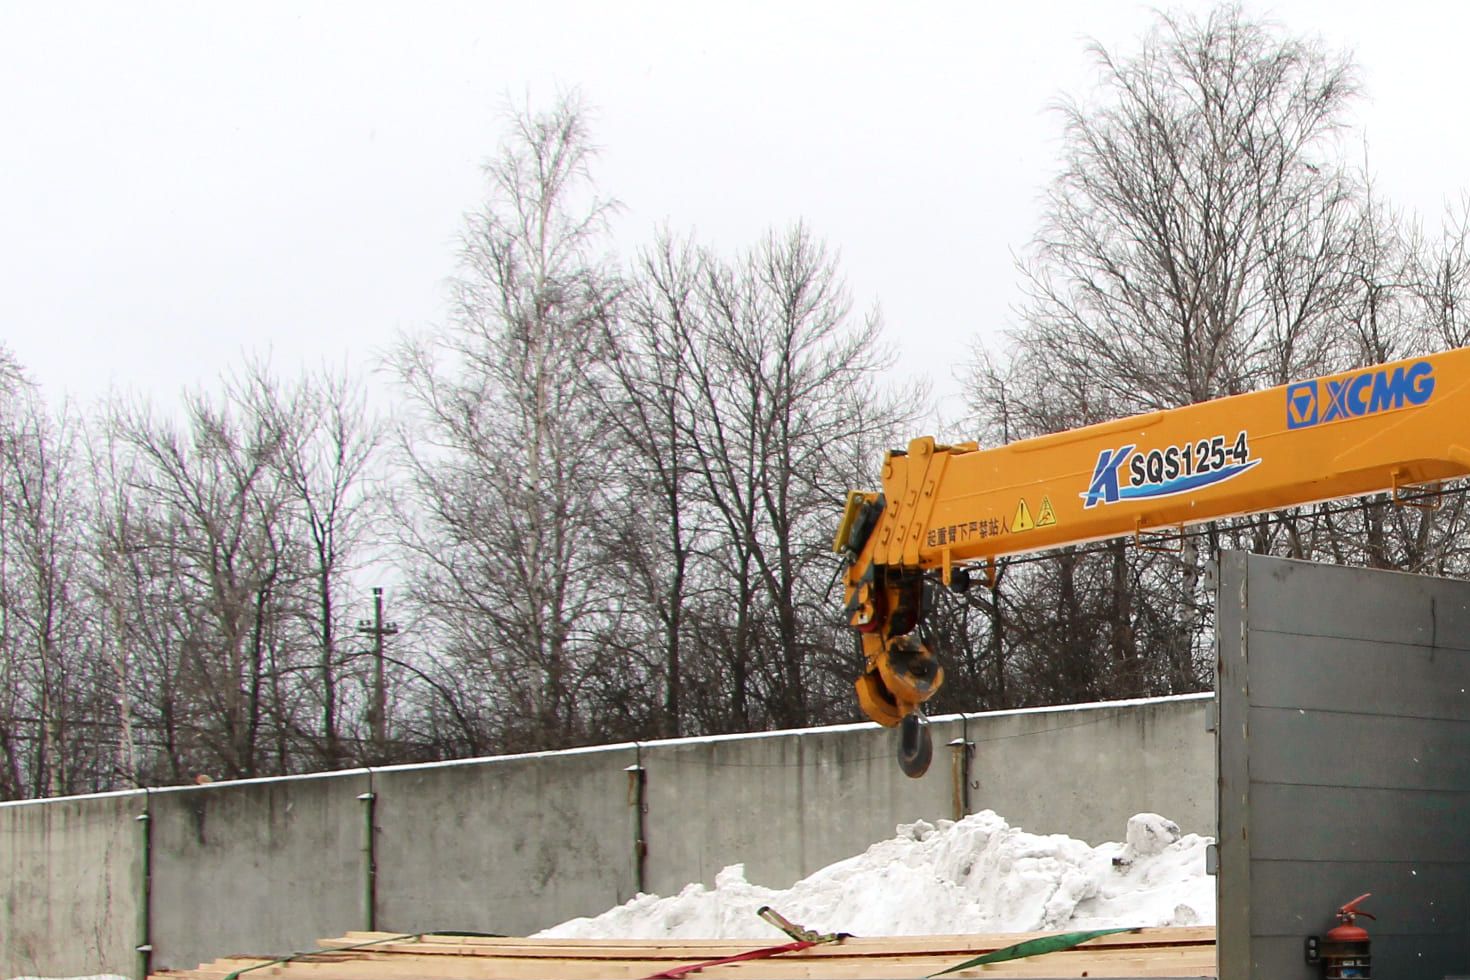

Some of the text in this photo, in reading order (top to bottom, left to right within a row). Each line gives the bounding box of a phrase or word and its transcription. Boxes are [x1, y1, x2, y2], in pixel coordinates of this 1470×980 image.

[1319, 361, 1435, 424] XCMG
[1130, 432, 1249, 487] SQS125-4
[927, 516, 1009, 547] 起重臂下严禁站人
